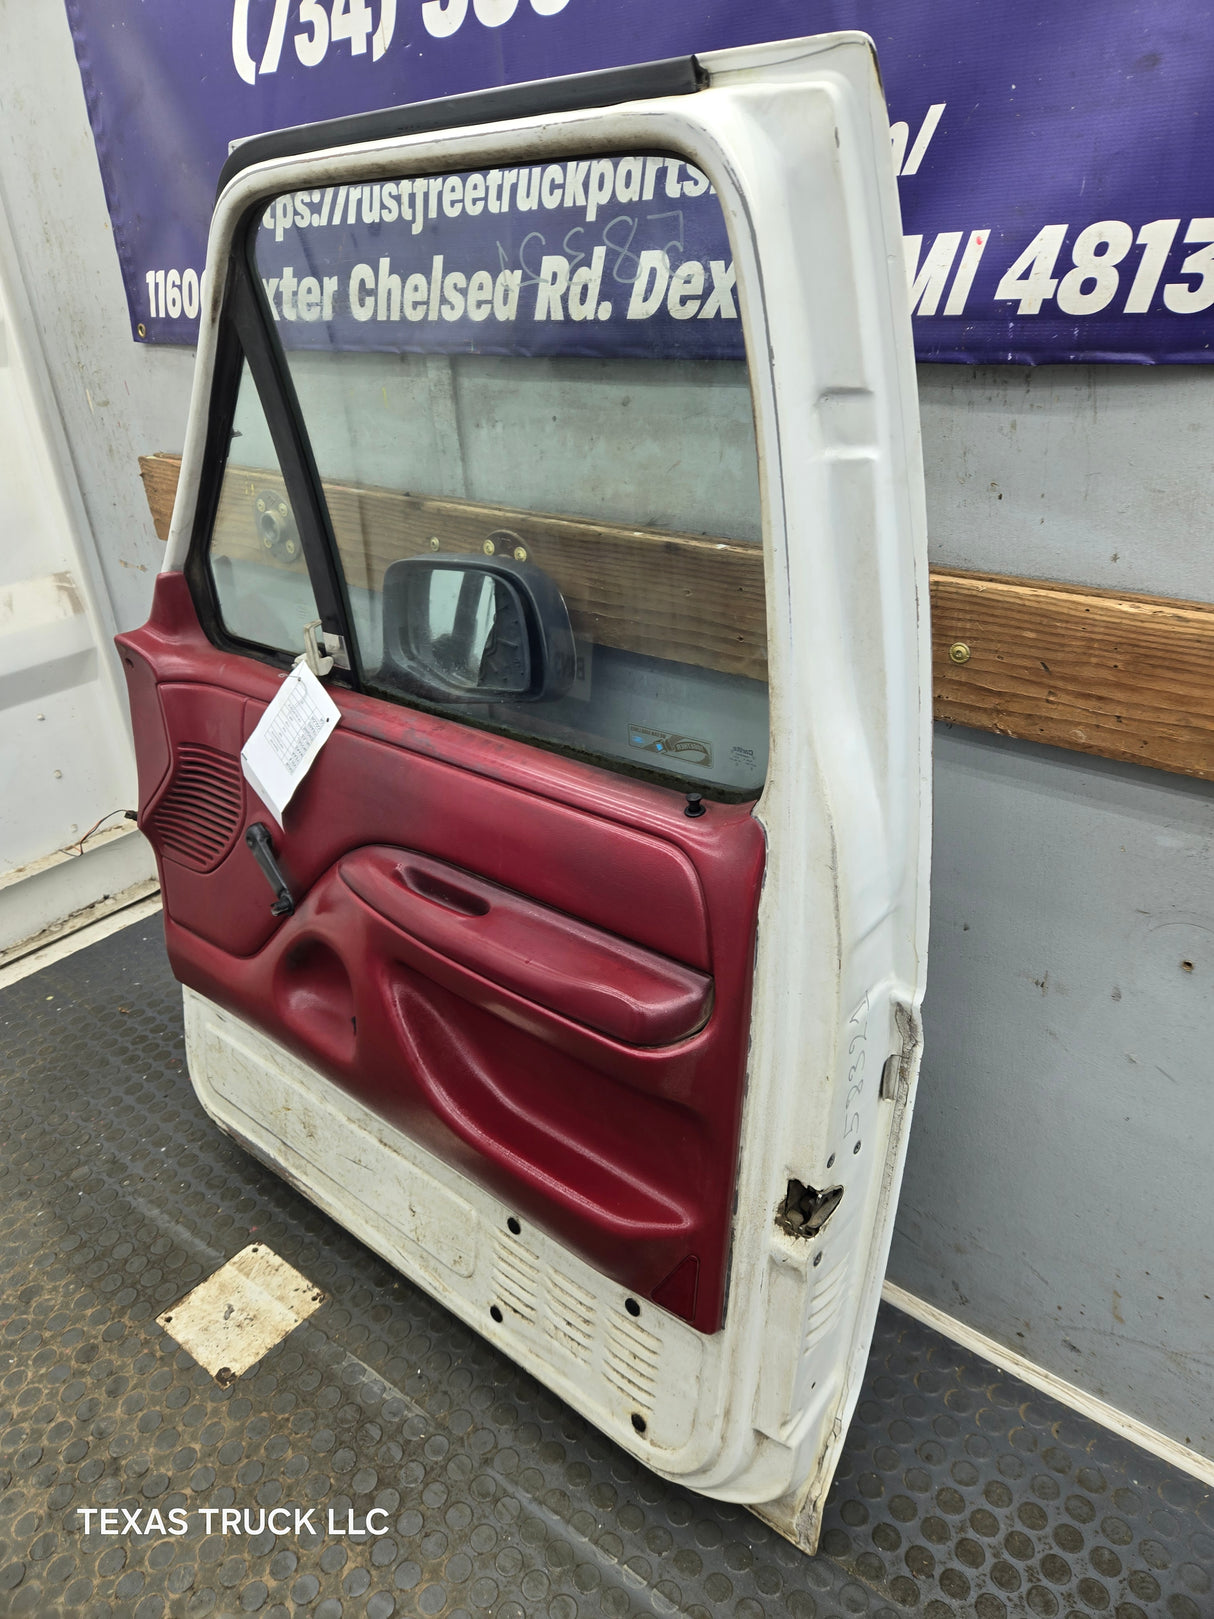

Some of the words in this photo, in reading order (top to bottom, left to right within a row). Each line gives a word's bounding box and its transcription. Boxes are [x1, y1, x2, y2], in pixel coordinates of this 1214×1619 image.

[145, 268, 207, 319] 1160
[350, 254, 523, 322] Chelsea
[534, 245, 612, 322] Rd.
[627, 249, 738, 320] Dex
[994, 217, 1214, 316] 4813
